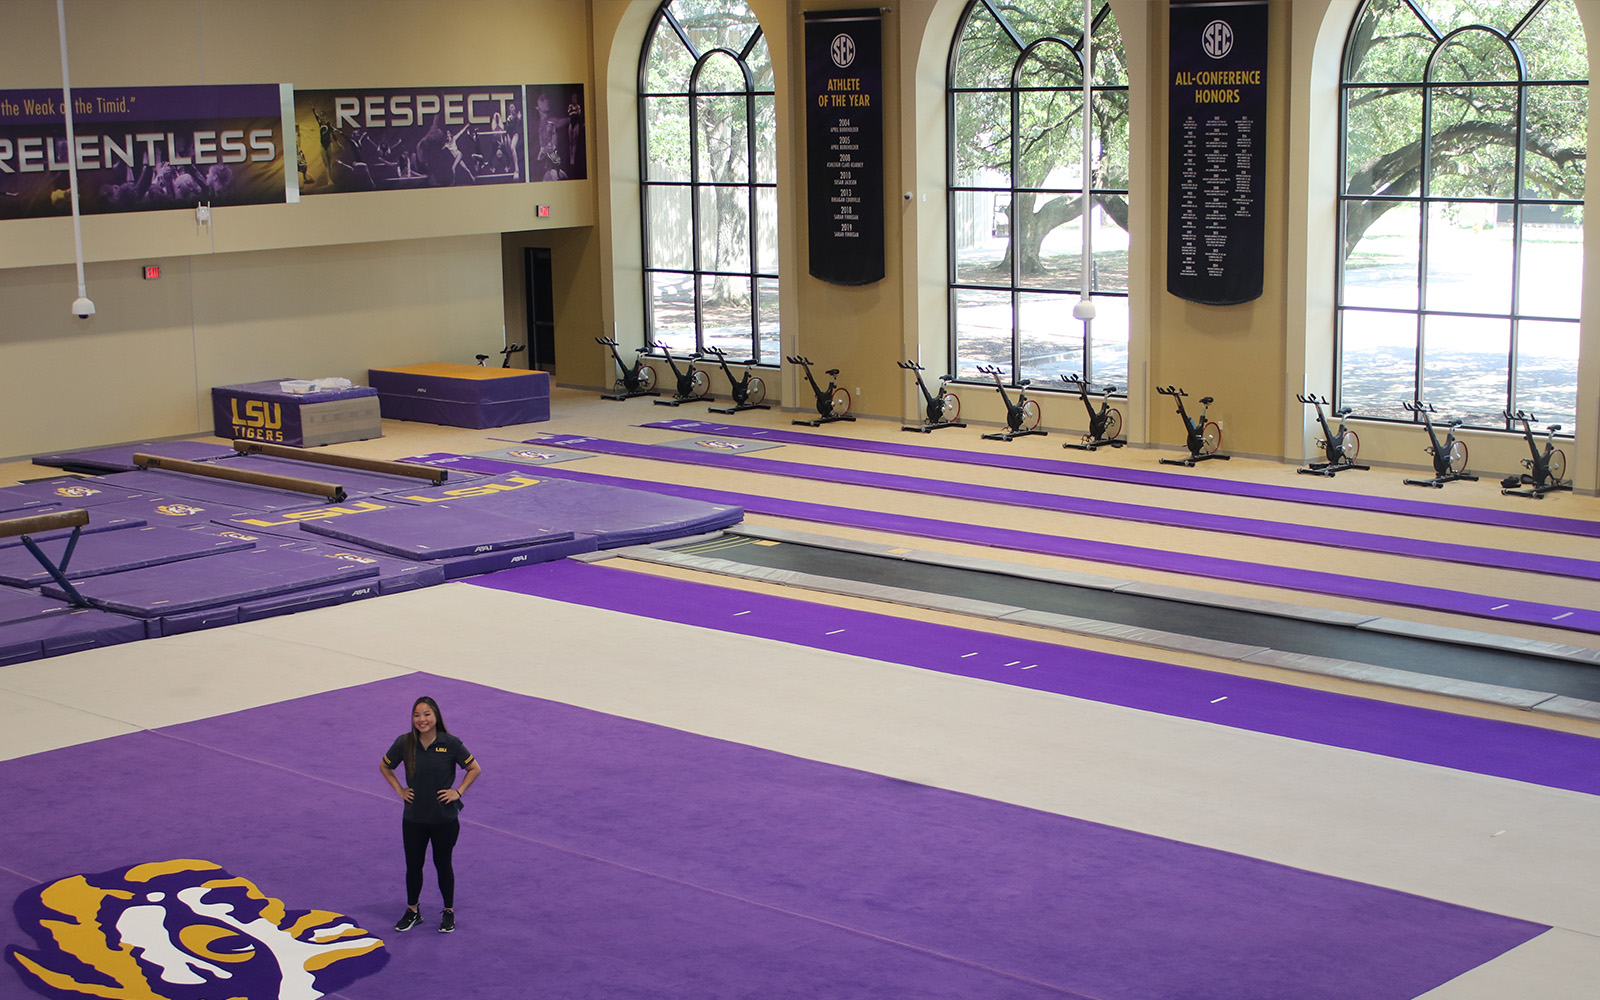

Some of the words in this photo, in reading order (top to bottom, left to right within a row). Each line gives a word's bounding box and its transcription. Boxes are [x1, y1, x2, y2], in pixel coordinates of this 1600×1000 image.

[833, 36, 853, 65] SEC
[1205, 23, 1231, 56] SEC
[827, 78, 860, 91] ATHLETE
[1175, 70, 1261, 85] ALL-CONFERENCE
[1, 98, 20, 116] the
[23, 97, 56, 116] Weak
[75, 97, 93, 114] the
[818, 95, 829, 107] OF
[831, 94, 847, 107] THE
[849, 94, 870, 107] YEAR
[1195, 89, 1240, 104] HONORS
[334, 91, 514, 129] RESPECT
[231, 398, 282, 429] LSU
[232, 425, 284, 442] TIGERS
[404, 477, 540, 503] LSU
[240, 502, 387, 528] LSU
